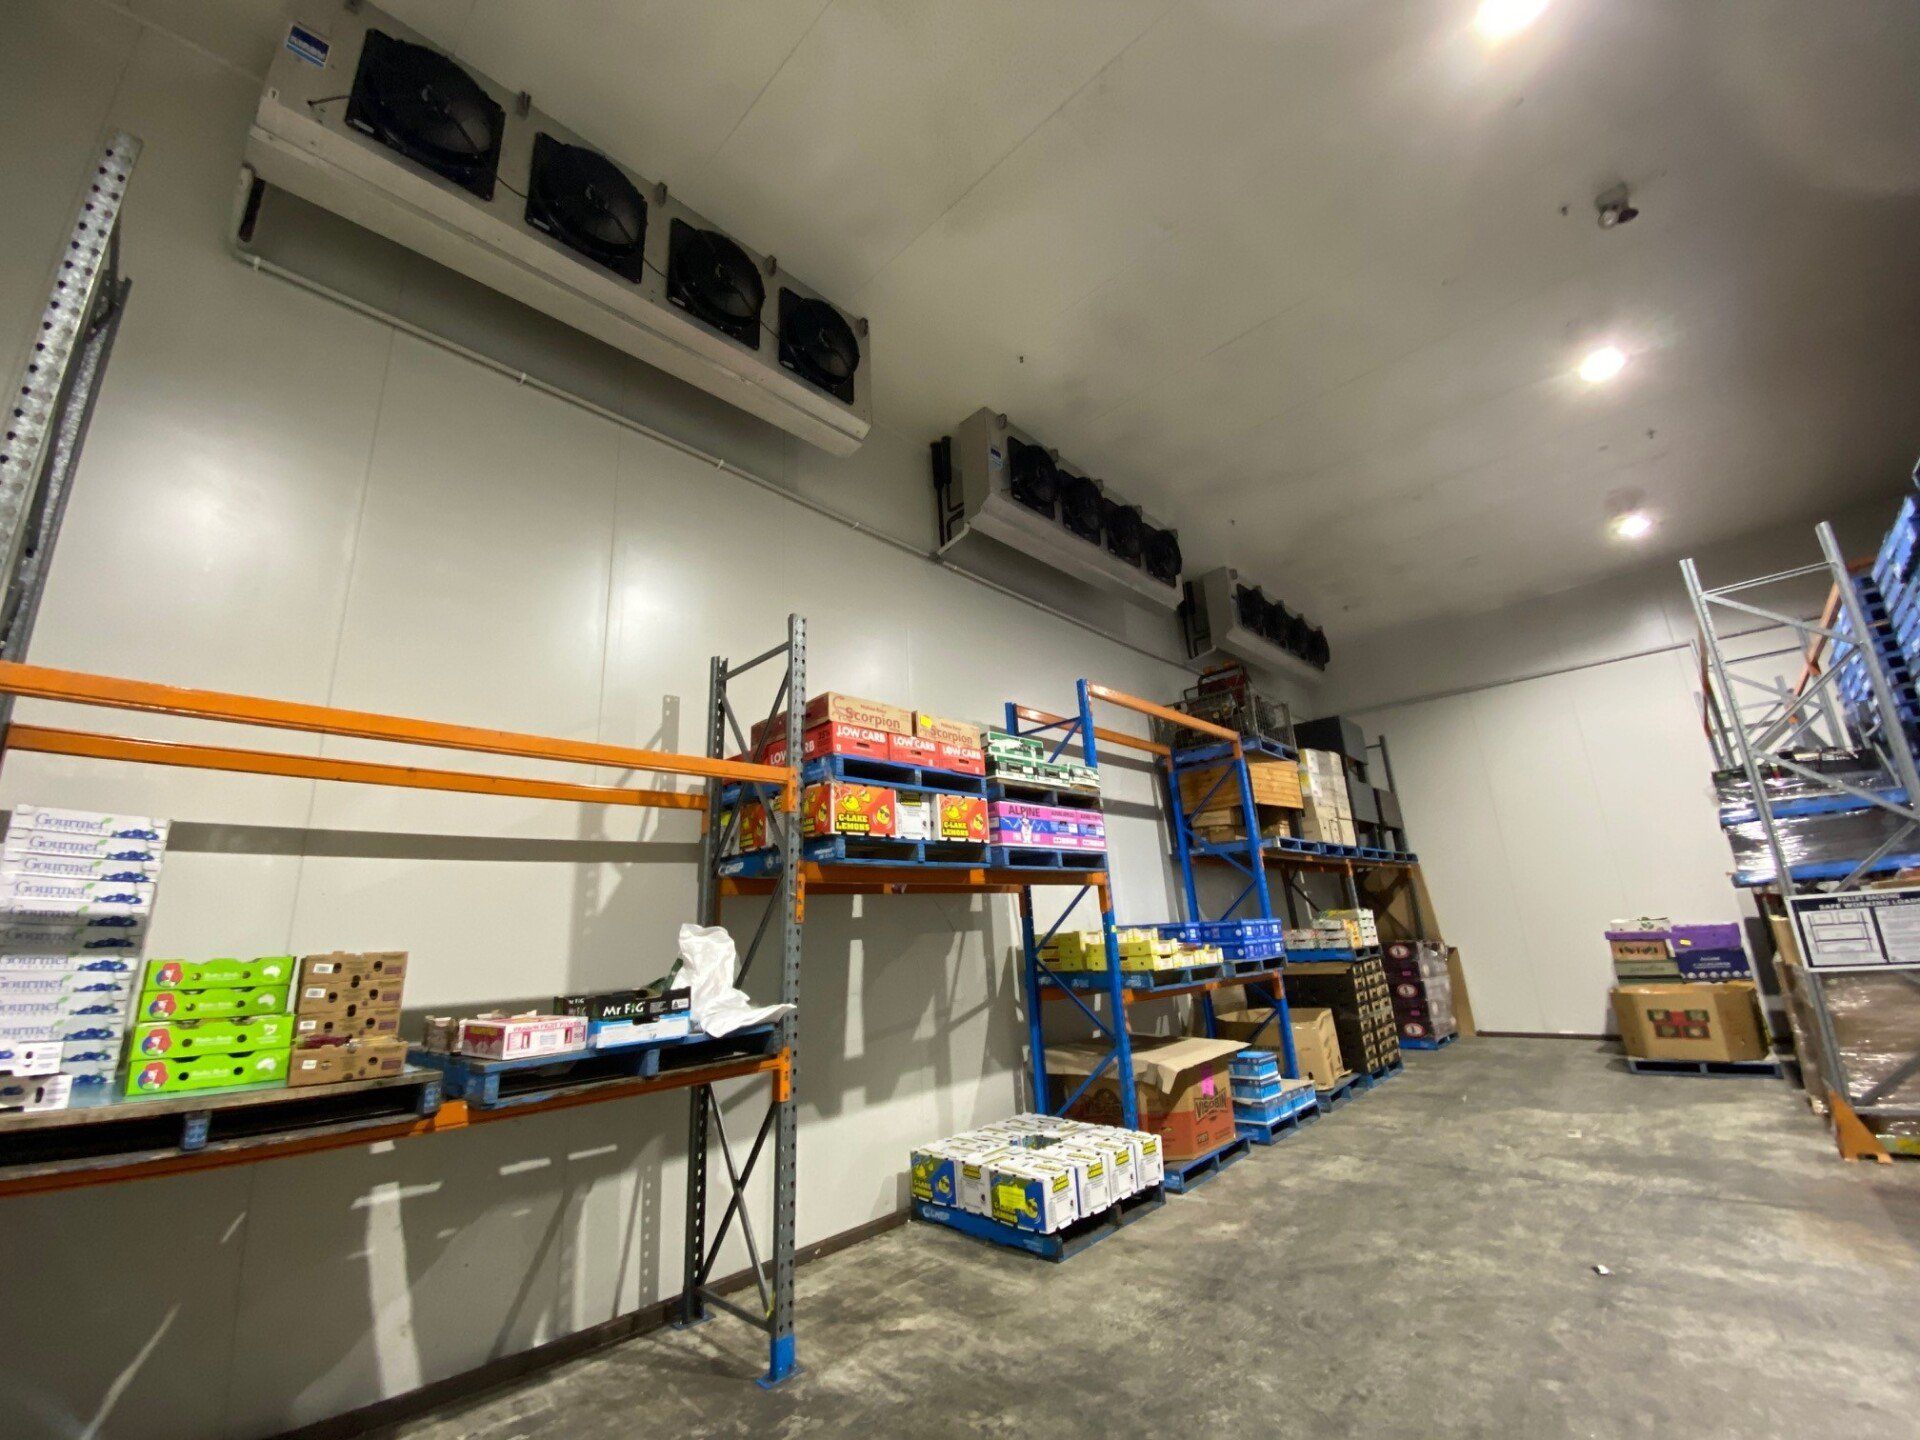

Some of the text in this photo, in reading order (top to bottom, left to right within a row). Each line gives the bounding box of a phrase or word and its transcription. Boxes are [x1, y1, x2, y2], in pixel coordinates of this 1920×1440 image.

[846, 706, 900, 729] Scorpion
[837, 725, 860, 738] LOW
[862, 729, 886, 743] CARB
[930, 725, 973, 745] Scorpion
[893, 737, 936, 752] LOW CARB
[943, 744, 961, 756] LOW
[1008, 805, 1041, 818] ALPINE
[35, 813, 104, 830] Gourmet
[836, 823, 870, 831] LEMONS
[29, 835, 98, 851] Gourmet
[24, 857, 94, 873] Gourmet
[15, 880, 86, 896] Gourmet
[1844, 899, 1889, 908] WORKING
[0, 1002, 58, 1011] ourmet
[603, 1005, 622, 1017] Mr
